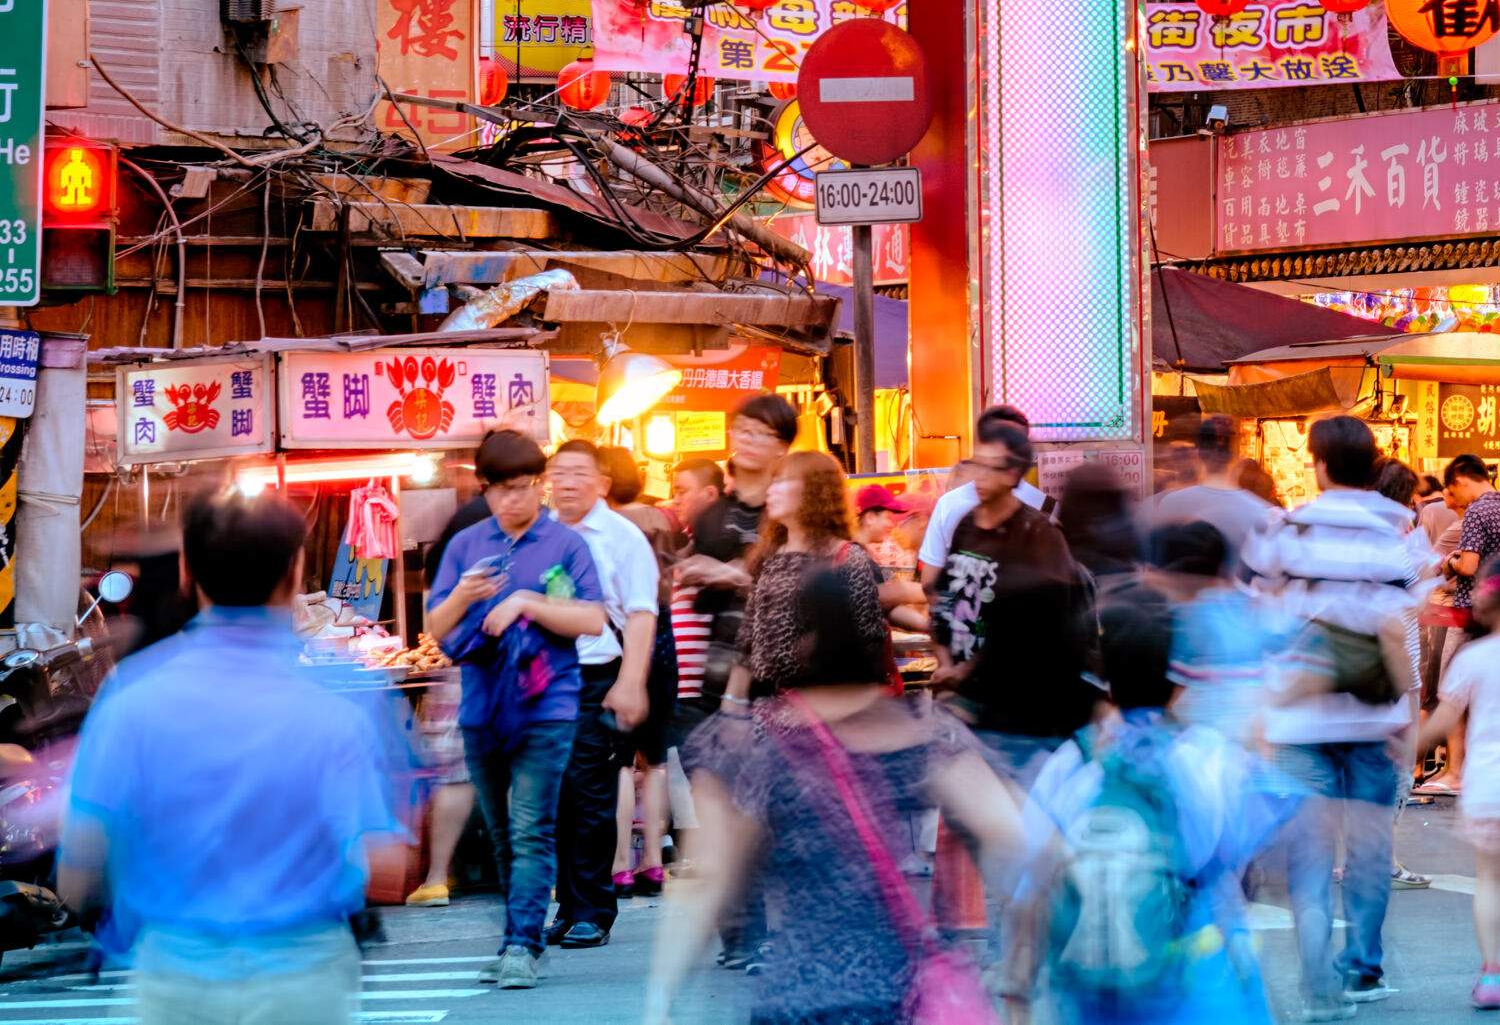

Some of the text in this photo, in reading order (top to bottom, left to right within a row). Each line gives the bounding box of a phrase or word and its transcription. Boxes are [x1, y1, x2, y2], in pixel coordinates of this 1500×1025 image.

[503, 15, 594, 44] 流行精
[818, 181, 915, 209] 16:00-24:00
[1312, 135, 1448, 217] 三禾百貨
[131, 378, 156, 446] 蟹肉
